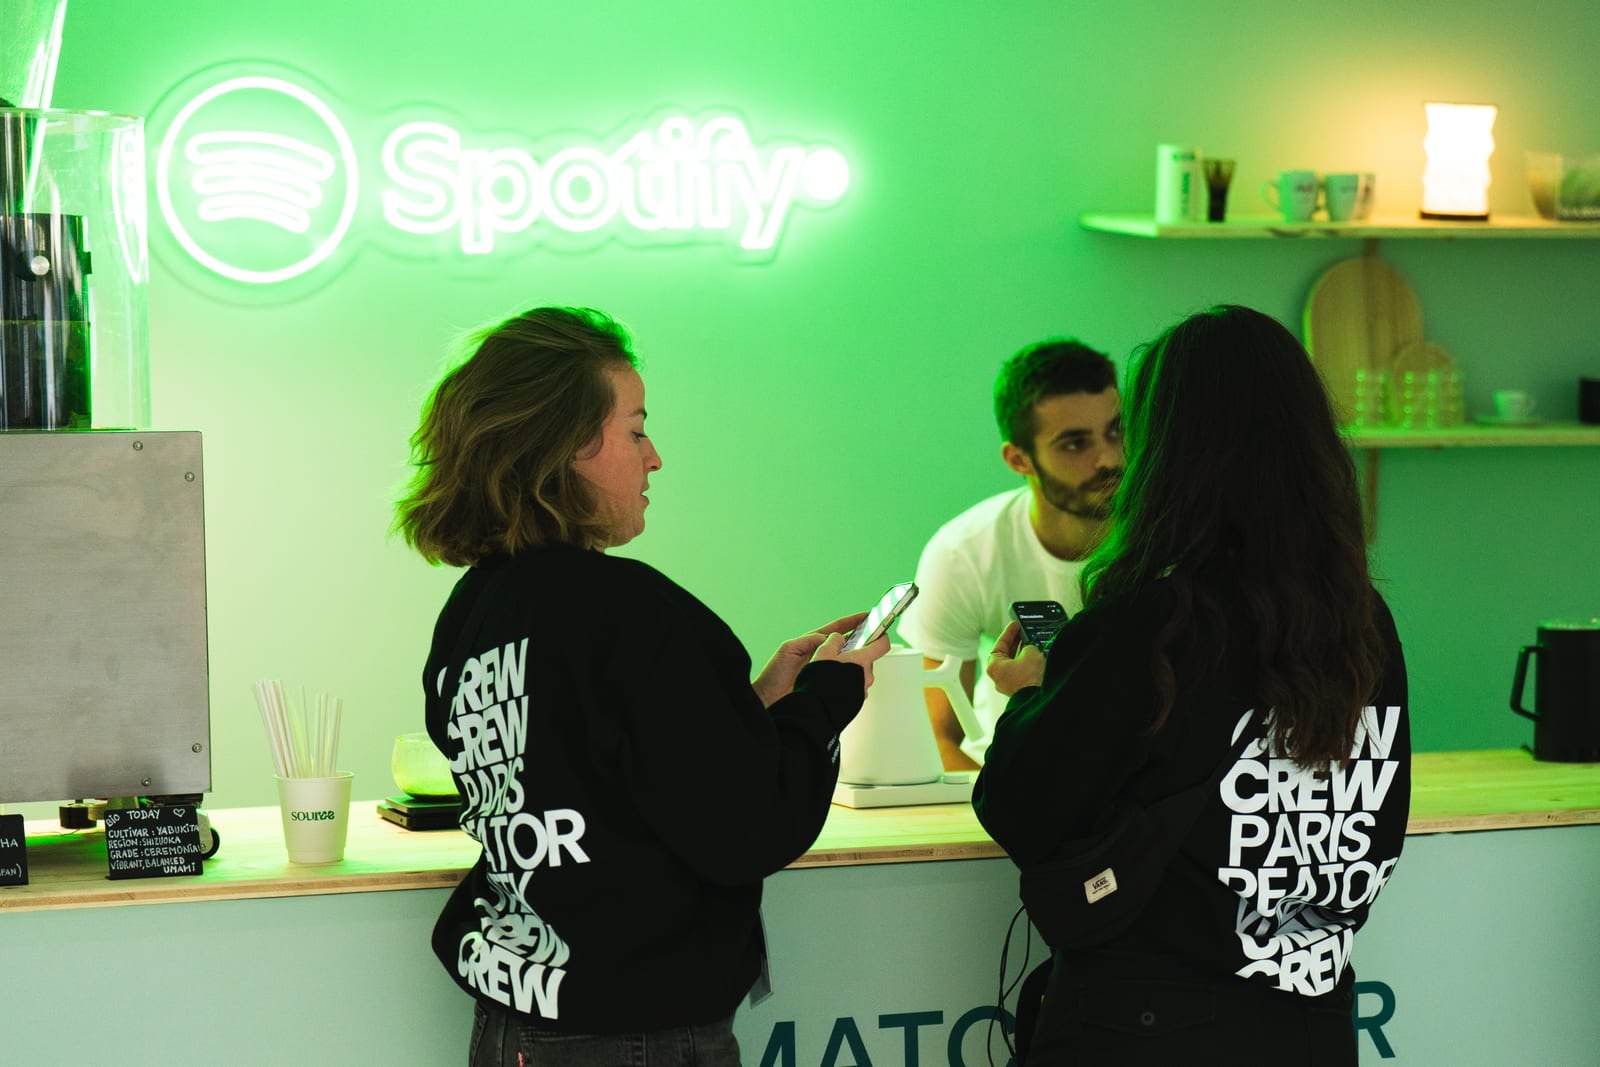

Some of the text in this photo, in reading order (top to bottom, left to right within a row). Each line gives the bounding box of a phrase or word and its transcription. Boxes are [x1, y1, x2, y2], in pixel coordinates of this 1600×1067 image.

[382, 116, 804, 254] Spotify
[127, 809, 160, 820] TODAY
[1219, 759, 1400, 814] CREW
[460, 808, 591, 873] ATOR
[1229, 811, 1376, 867] PARIS
[457, 930, 568, 1020] CREW
